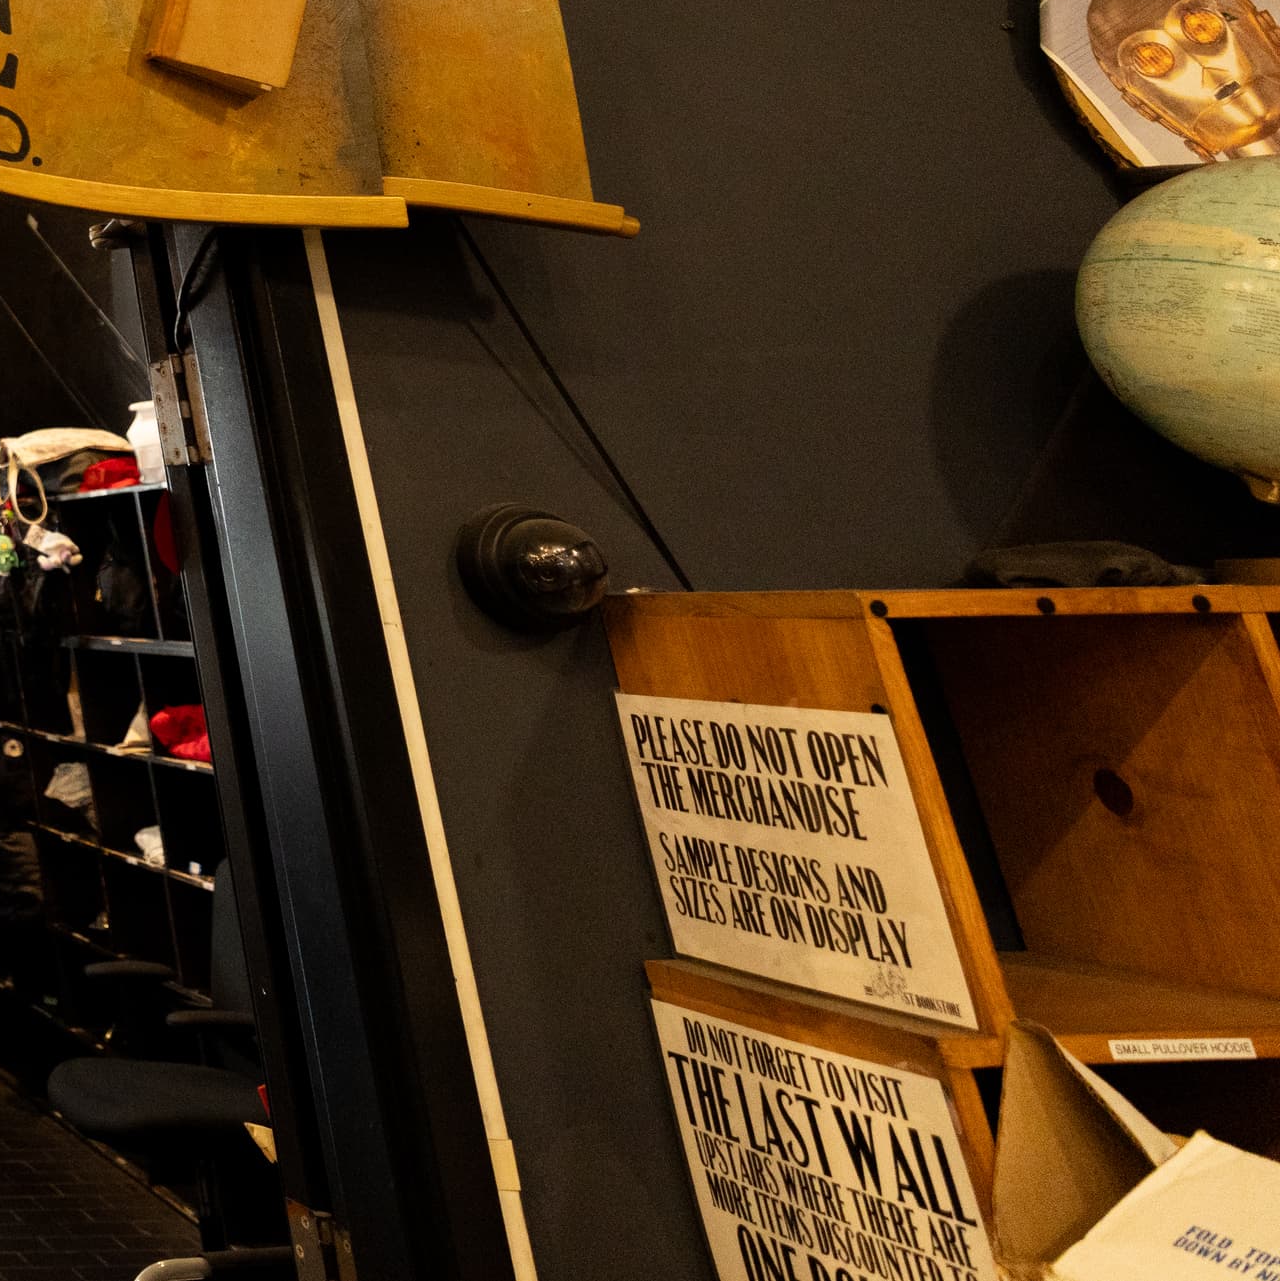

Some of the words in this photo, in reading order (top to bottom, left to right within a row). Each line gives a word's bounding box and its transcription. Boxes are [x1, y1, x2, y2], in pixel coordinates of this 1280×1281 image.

[630, 713, 713, 768] PLEASE
[710, 721, 747, 772] DO
[745, 724, 803, 779] NOT
[806, 730, 889, 789] OPEN
[641, 761, 689, 814] THE
[688, 767, 868, 842] MERCHANDISE
[659, 831, 738, 887] SAMPLE
[735, 844, 831, 904] DESIGNS
[834, 862, 888, 915] AND
[670, 875, 728, 926] SIZES
[730, 889, 772, 938] ARE
[770, 895, 808, 945] ON
[804, 903, 913, 969] DISPLAY
[682, 1016, 709, 1058] DO
[706, 1023, 744, 1070] NOT
[742, 1035, 813, 1093] FORGET
[810, 1055, 846, 1103] TO
[842, 1064, 910, 1122] VISIT
[1114, 1042, 1151, 1055] SMALL
[1152, 1041, 1209, 1055] PULLOVER
[1210, 1040, 1253, 1054] HOODIE
[667, 1050, 740, 1144] THE
[735, 1072, 833, 1178] LAST
[831, 1103, 978, 1228] WALL
[692, 1126, 781, 1197] UPSTAIRS
[777, 1159, 851, 1226] WHERE
[846, 1186, 925, 1252] THERE
[926, 1215, 979, 1272] ARE
[704, 1170, 757, 1226] MORE
[753, 1190, 815, 1250] ITEMS
[811, 1213, 945, 1281] DISCOUNTED
[1185, 1225, 1233, 1249] FOLD
[1172, 1235, 1228, 1264] DOWN
[1227, 1257, 1255, 1273] BY
